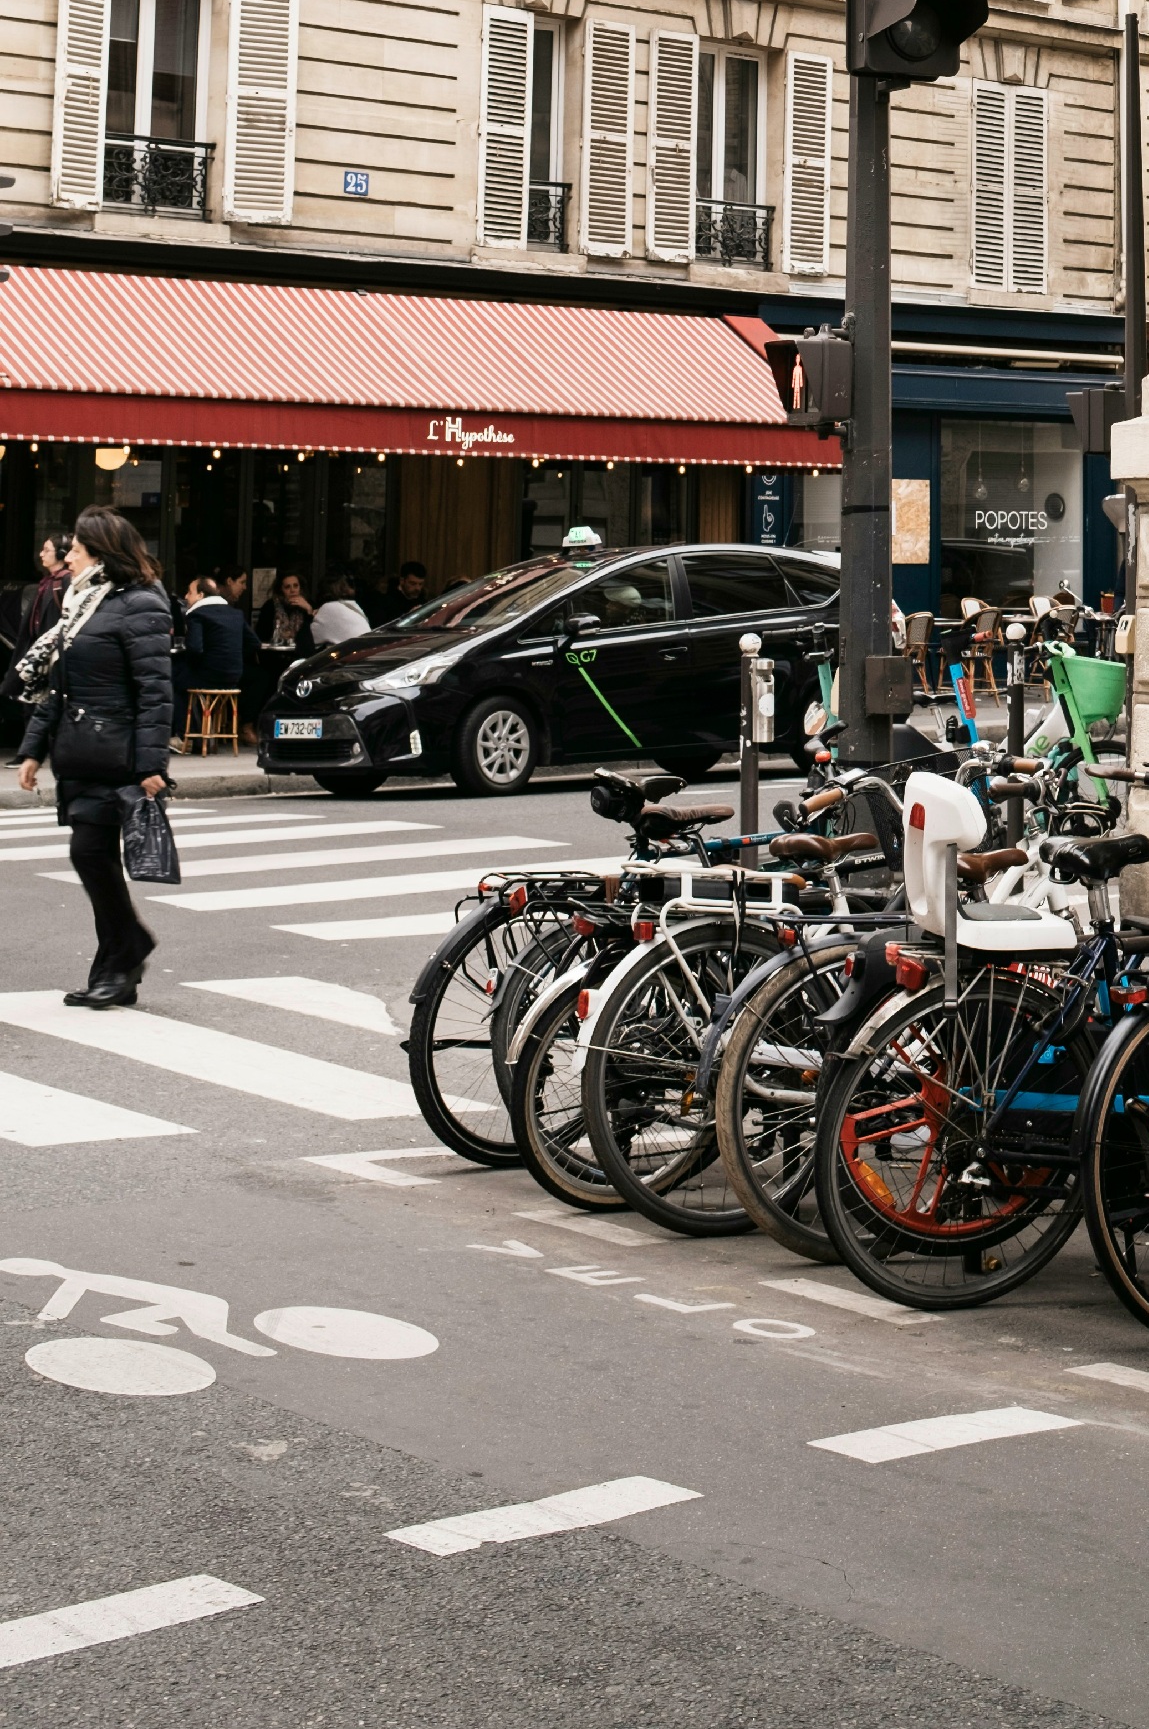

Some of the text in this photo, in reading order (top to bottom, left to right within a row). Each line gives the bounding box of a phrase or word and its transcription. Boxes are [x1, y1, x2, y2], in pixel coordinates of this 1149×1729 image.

[345, 172, 367, 193] 25
[426, 416, 515, 450] L'Hypothèse
[975, 510, 1048, 530] POPOTES
[580, 649, 598, 663] G7
[465, 1239, 817, 1339] VELO
